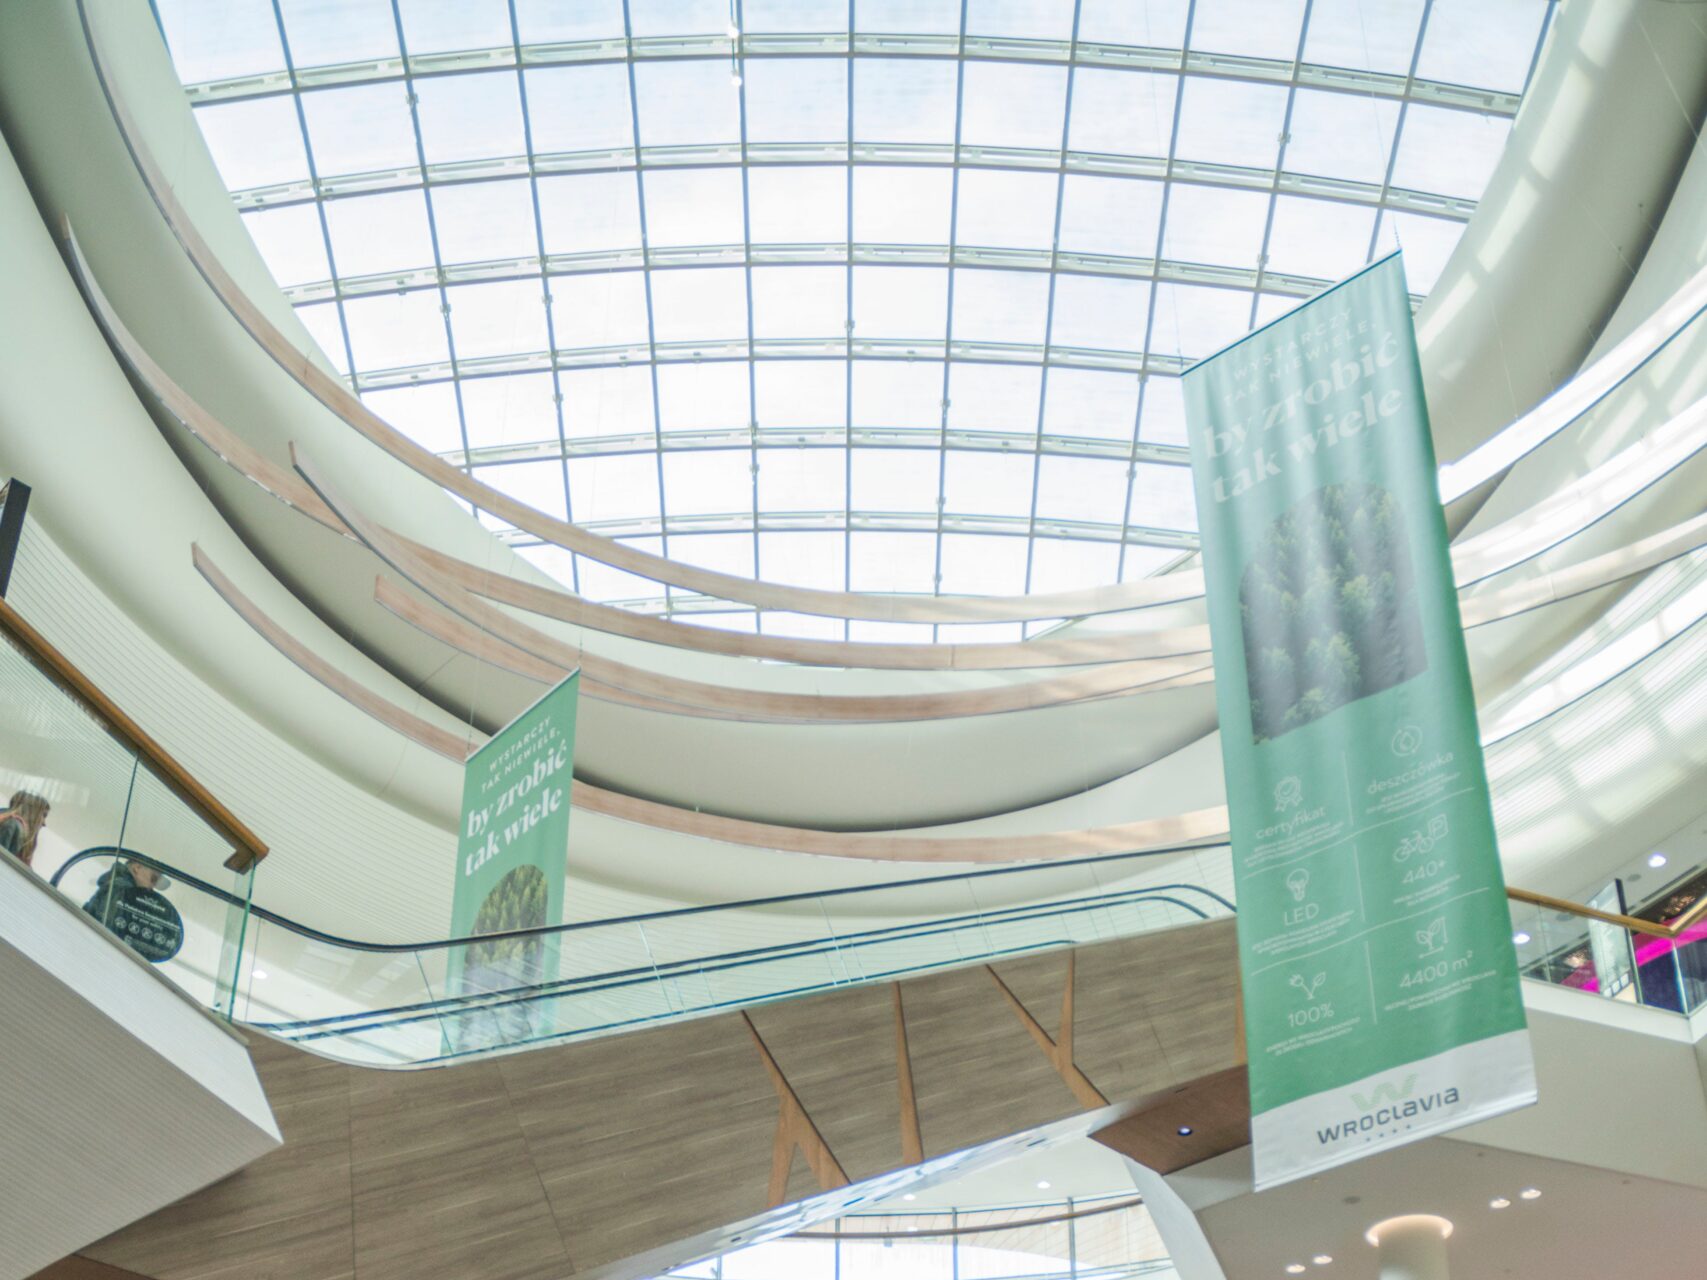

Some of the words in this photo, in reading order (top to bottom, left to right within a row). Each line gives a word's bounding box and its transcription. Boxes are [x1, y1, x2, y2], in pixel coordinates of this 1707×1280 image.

[1203, 420, 1254, 460] by
[1262, 332, 1400, 432] zrobić
[1211, 452, 1282, 503] tak
[1288, 389, 1403, 462] wiele
[489, 716, 550, 772] WYSTARCZY
[467, 803, 493, 838] by
[496, 738, 568, 817] zrobić
[481, 770, 503, 793] TAK
[1367, 752, 1454, 796] deszczówka
[465, 833, 500, 877] tak
[504, 787, 563, 845] wiele
[1255, 806, 1326, 841] certyfikat
[1283, 904, 1320, 926] LED
[1400, 961, 1449, 989] 4400
[1287, 1004, 1335, 1028] 100%
